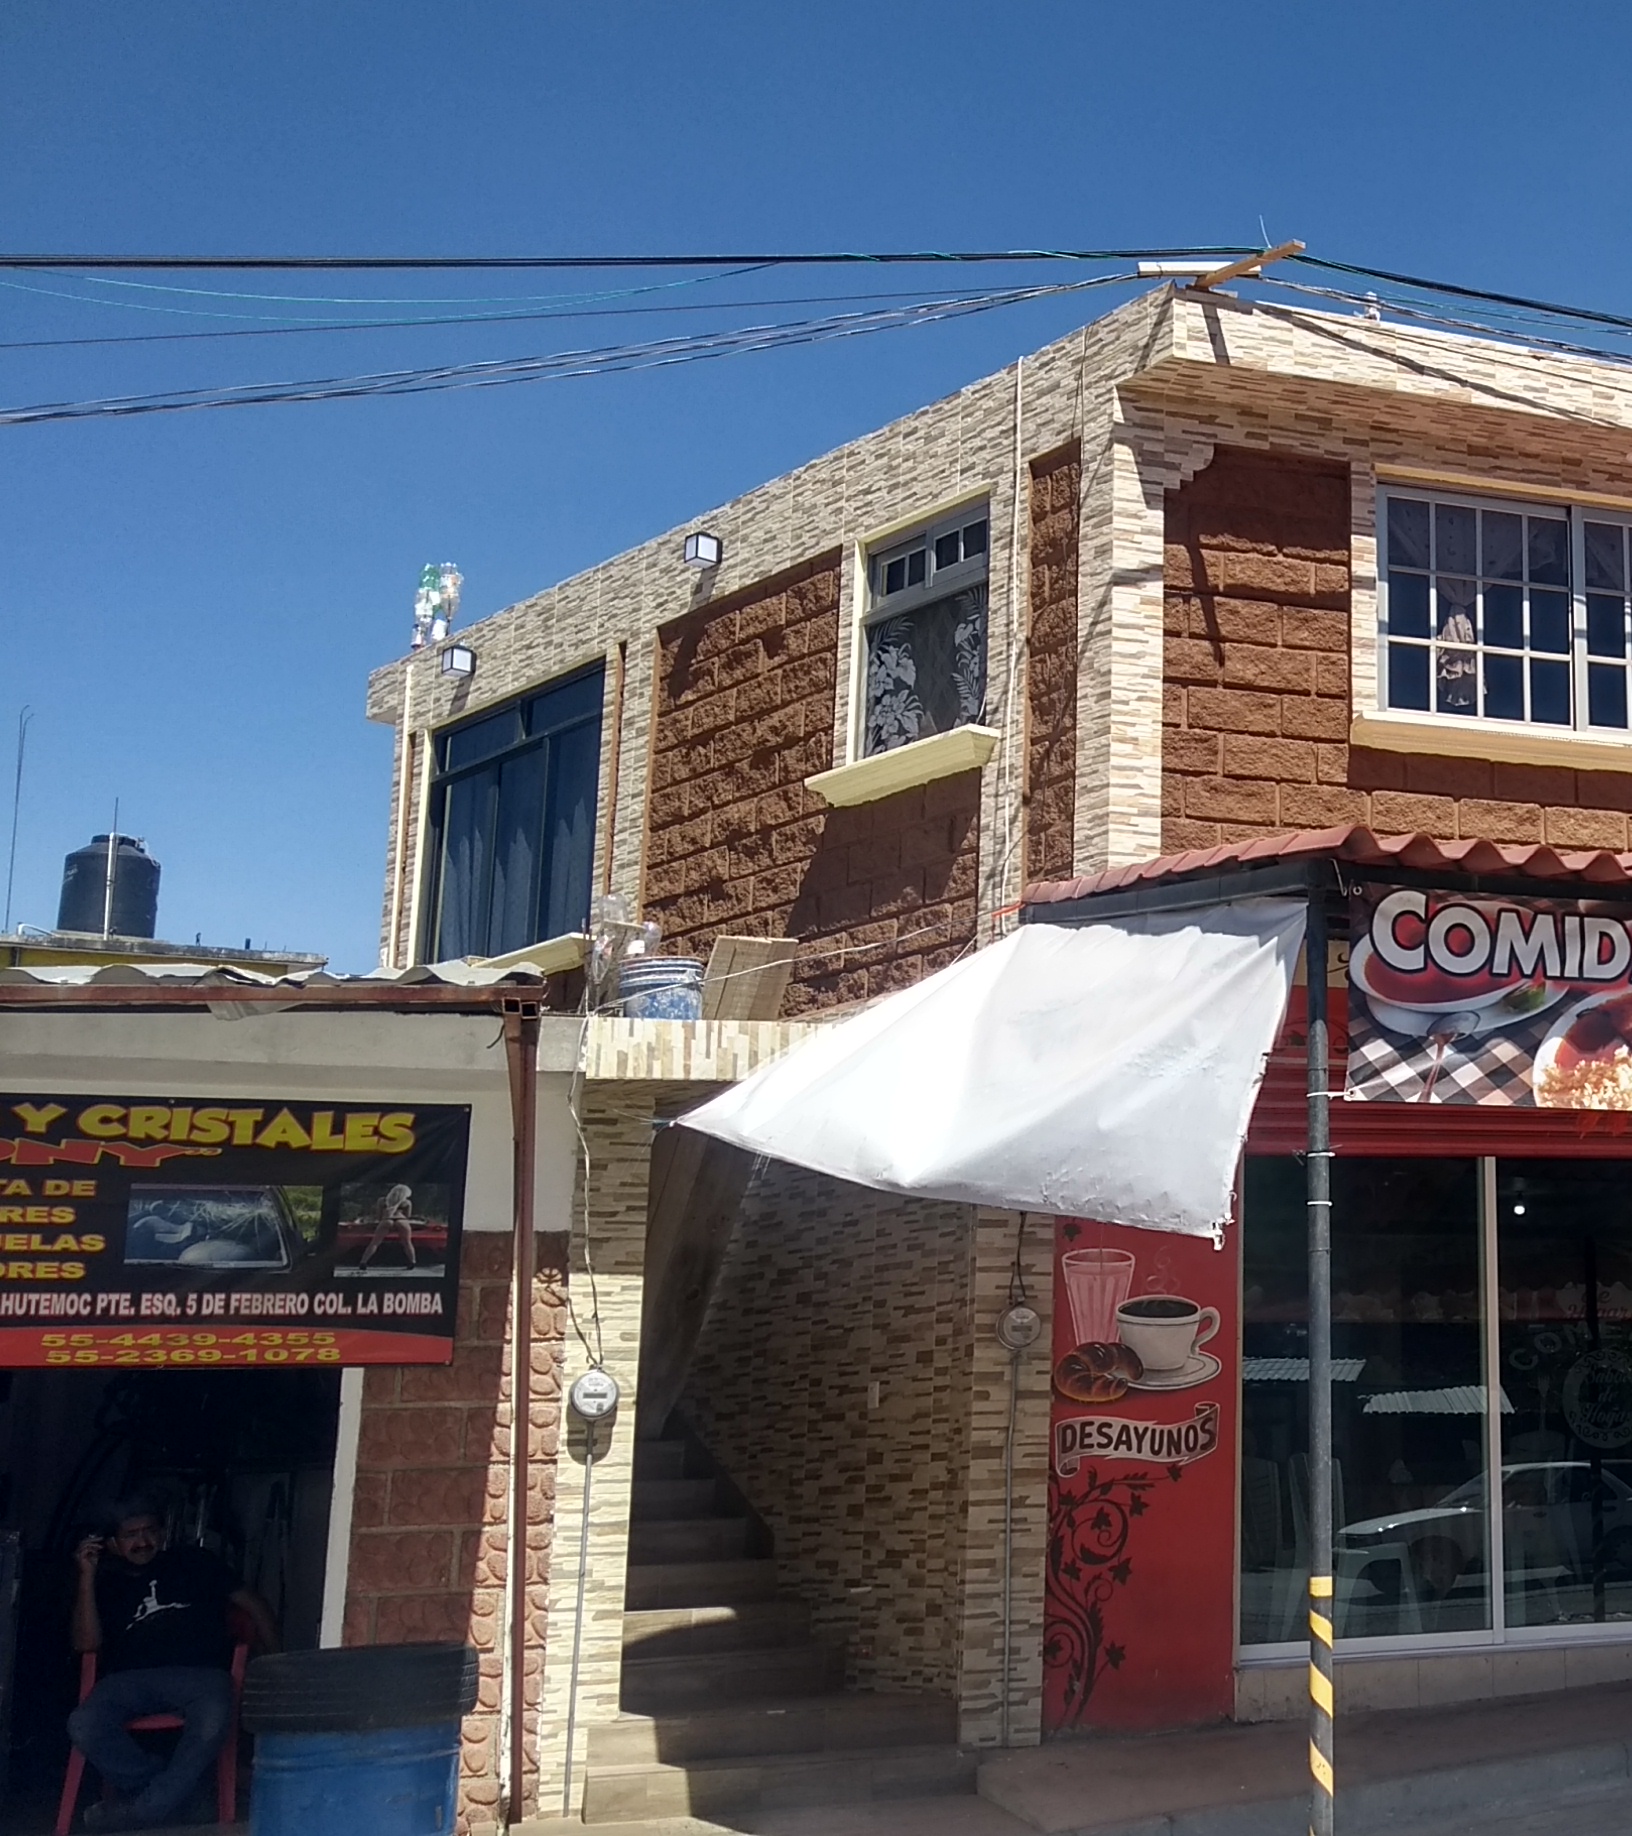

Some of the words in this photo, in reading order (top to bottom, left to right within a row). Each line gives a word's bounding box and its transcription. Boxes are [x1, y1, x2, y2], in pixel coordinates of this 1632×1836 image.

[12, 1102, 68, 1134] Y
[77, 1104, 416, 1154] CRISTALES
[44, 1179, 97, 1197] DE
[0, 1234, 105, 1252] ELAS
[96, 1292, 135, 1316] PTE.
[140, 1292, 181, 1318] ESQ.
[186, 1293, 197, 1316] 5
[201, 1293, 226, 1316] DE
[229, 1292, 309, 1316] FEBRERO
[313, 1292, 352, 1315] COL.
[356, 1292, 379, 1315] LA
[382, 1292, 443, 1315] BOMBA
[41, 1331, 336, 1348] 55-4439-4355
[45, 1347, 341, 1363] 55-2369-1078
[1061, 1417, 1214, 1457] DESAYUNOS
